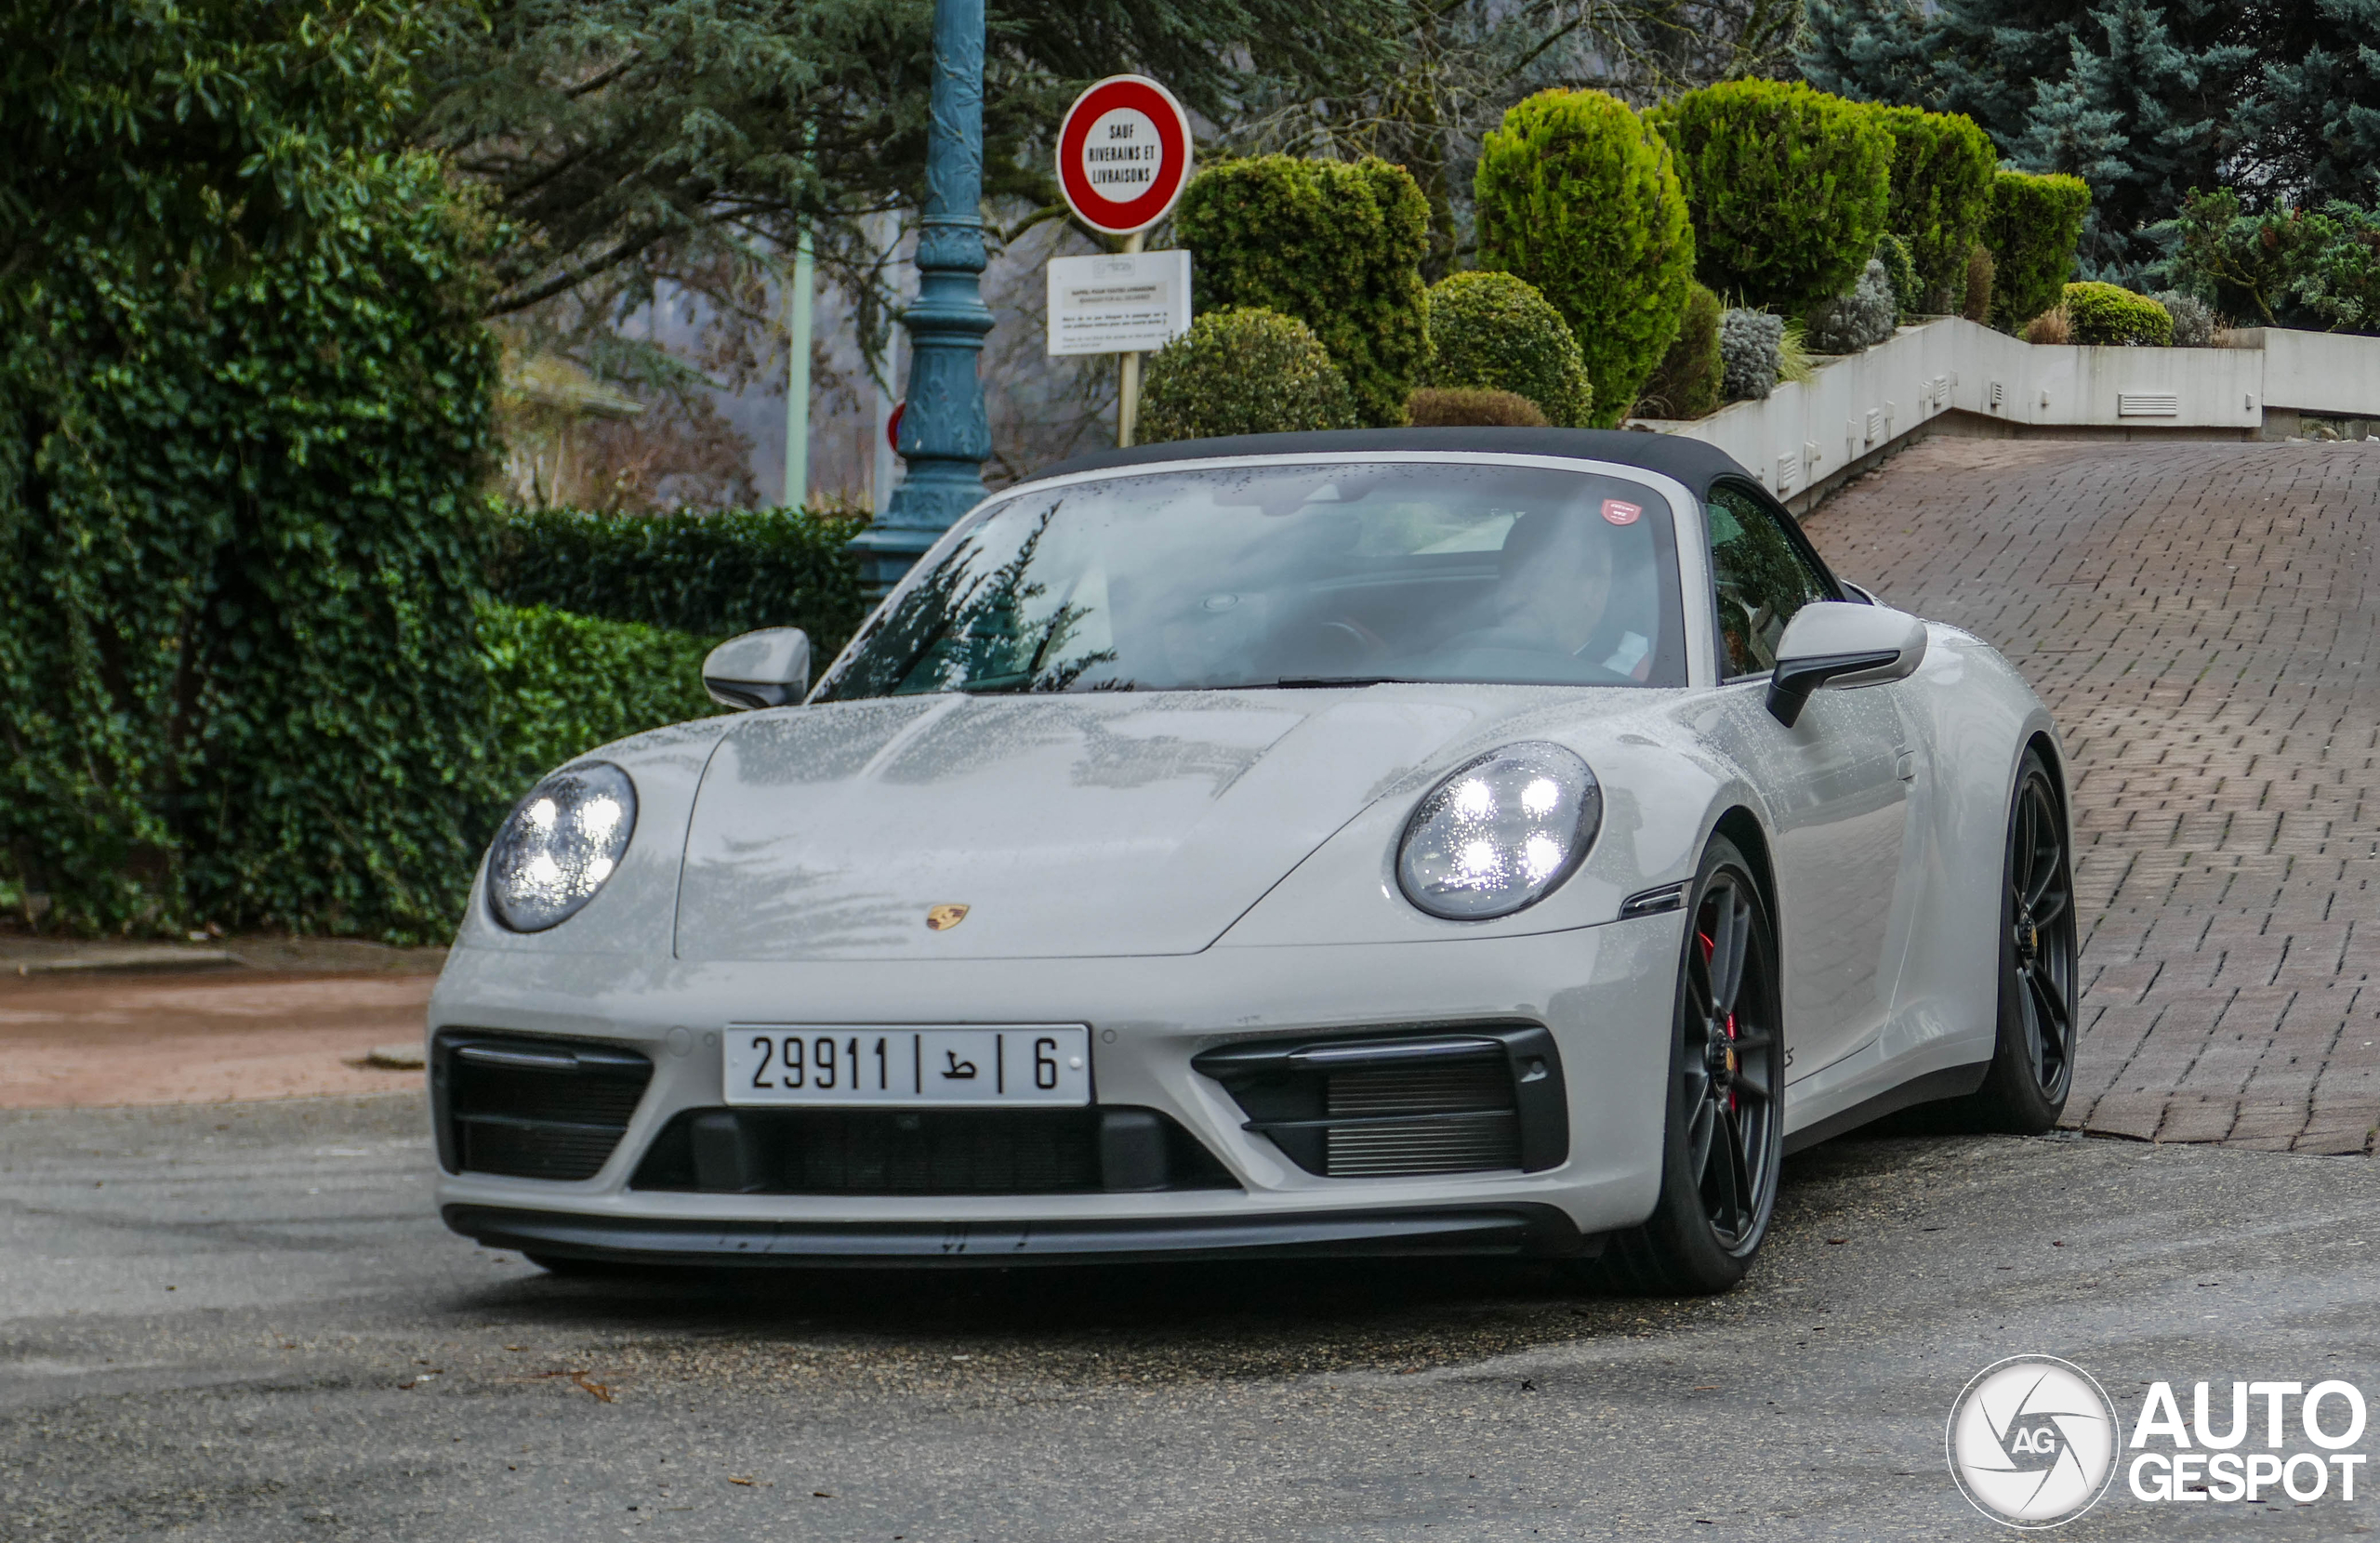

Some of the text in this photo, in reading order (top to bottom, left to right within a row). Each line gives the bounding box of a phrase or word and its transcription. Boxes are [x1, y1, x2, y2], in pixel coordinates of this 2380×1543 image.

[1110, 124, 1133, 138] SAUF
[1089, 145, 1155, 162] RIVERAINS ET
[1092, 167, 1150, 184] LIVRAISONS
[751, 1036, 887, 1090] 29911
[1035, 1037, 1058, 1090] 6
